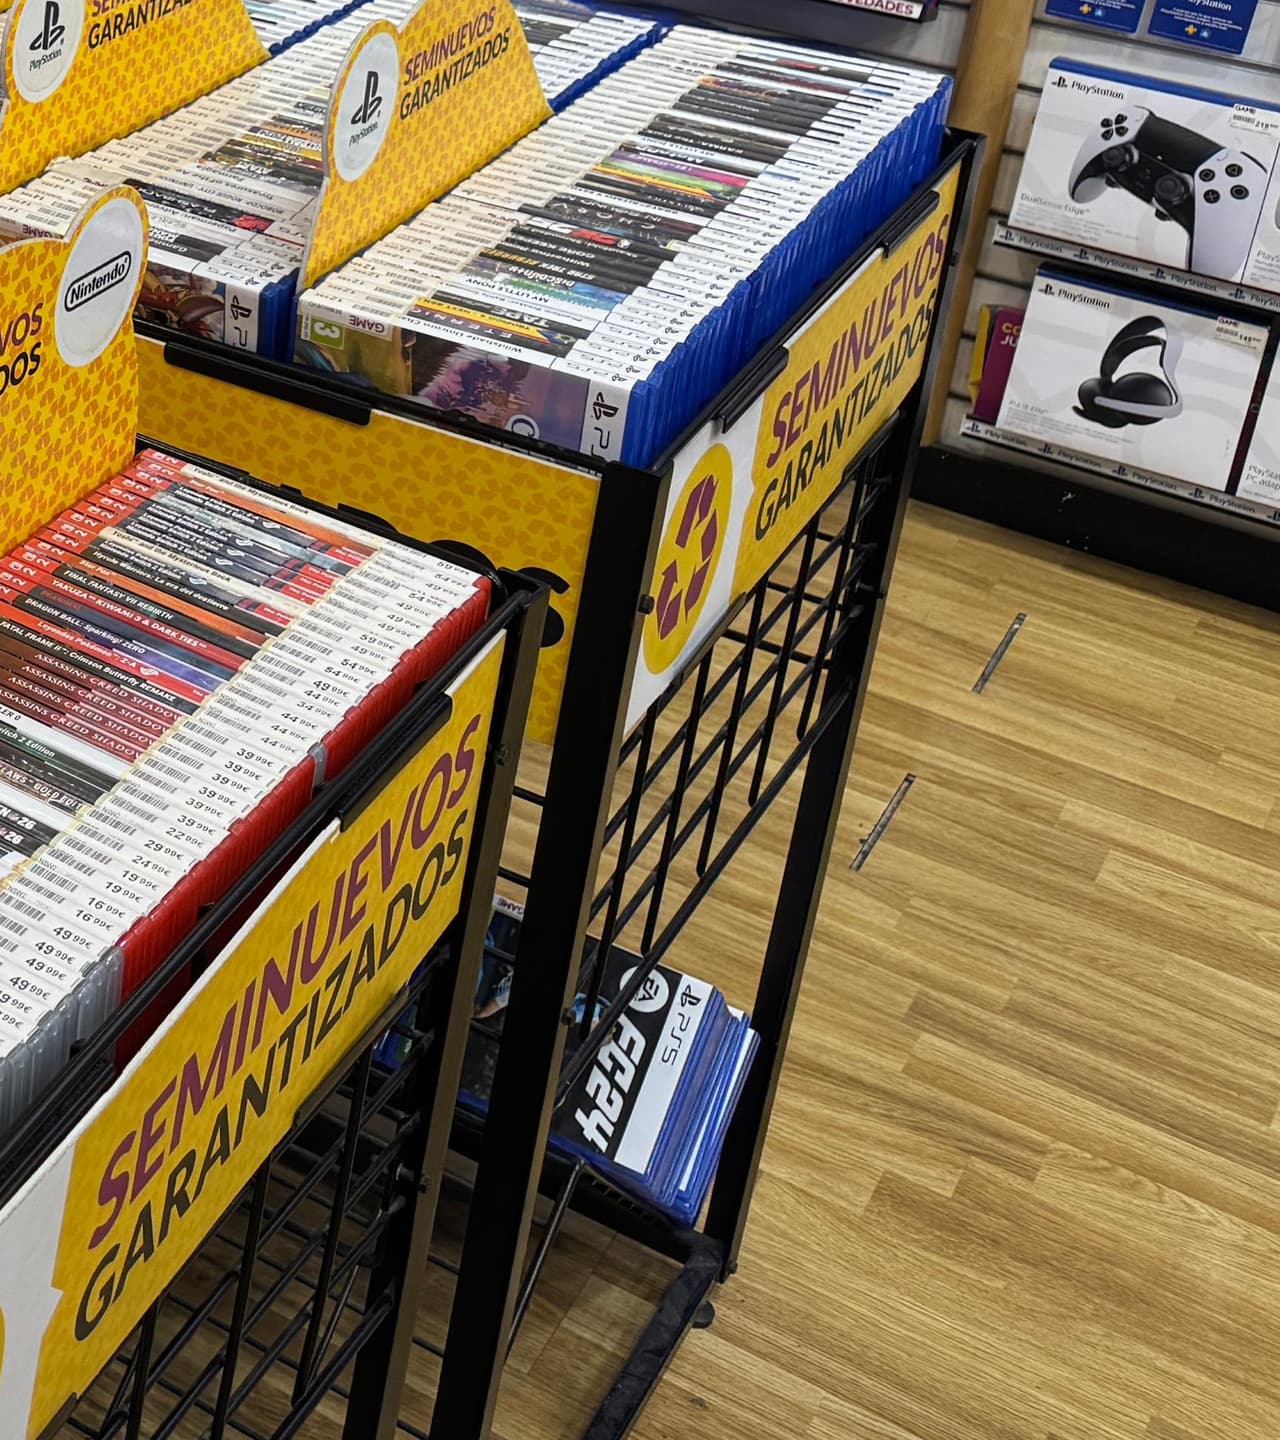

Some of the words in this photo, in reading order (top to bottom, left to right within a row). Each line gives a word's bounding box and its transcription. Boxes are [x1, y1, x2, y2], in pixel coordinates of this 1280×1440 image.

[1071, 80, 1124, 100] PlayStation
[755, 290, 934, 541] GARANTIZADOS
[766, 216, 950, 469] SEMINUEVOS
[64, 570, 86, 586] FINAL
[88, 580, 127, 603] FANTASY
[139, 602, 173, 621] REBIRTH
[73, 809, 467, 1343] GARANTIZADOS
[88, 713, 476, 1253] SEMINUEVOS
